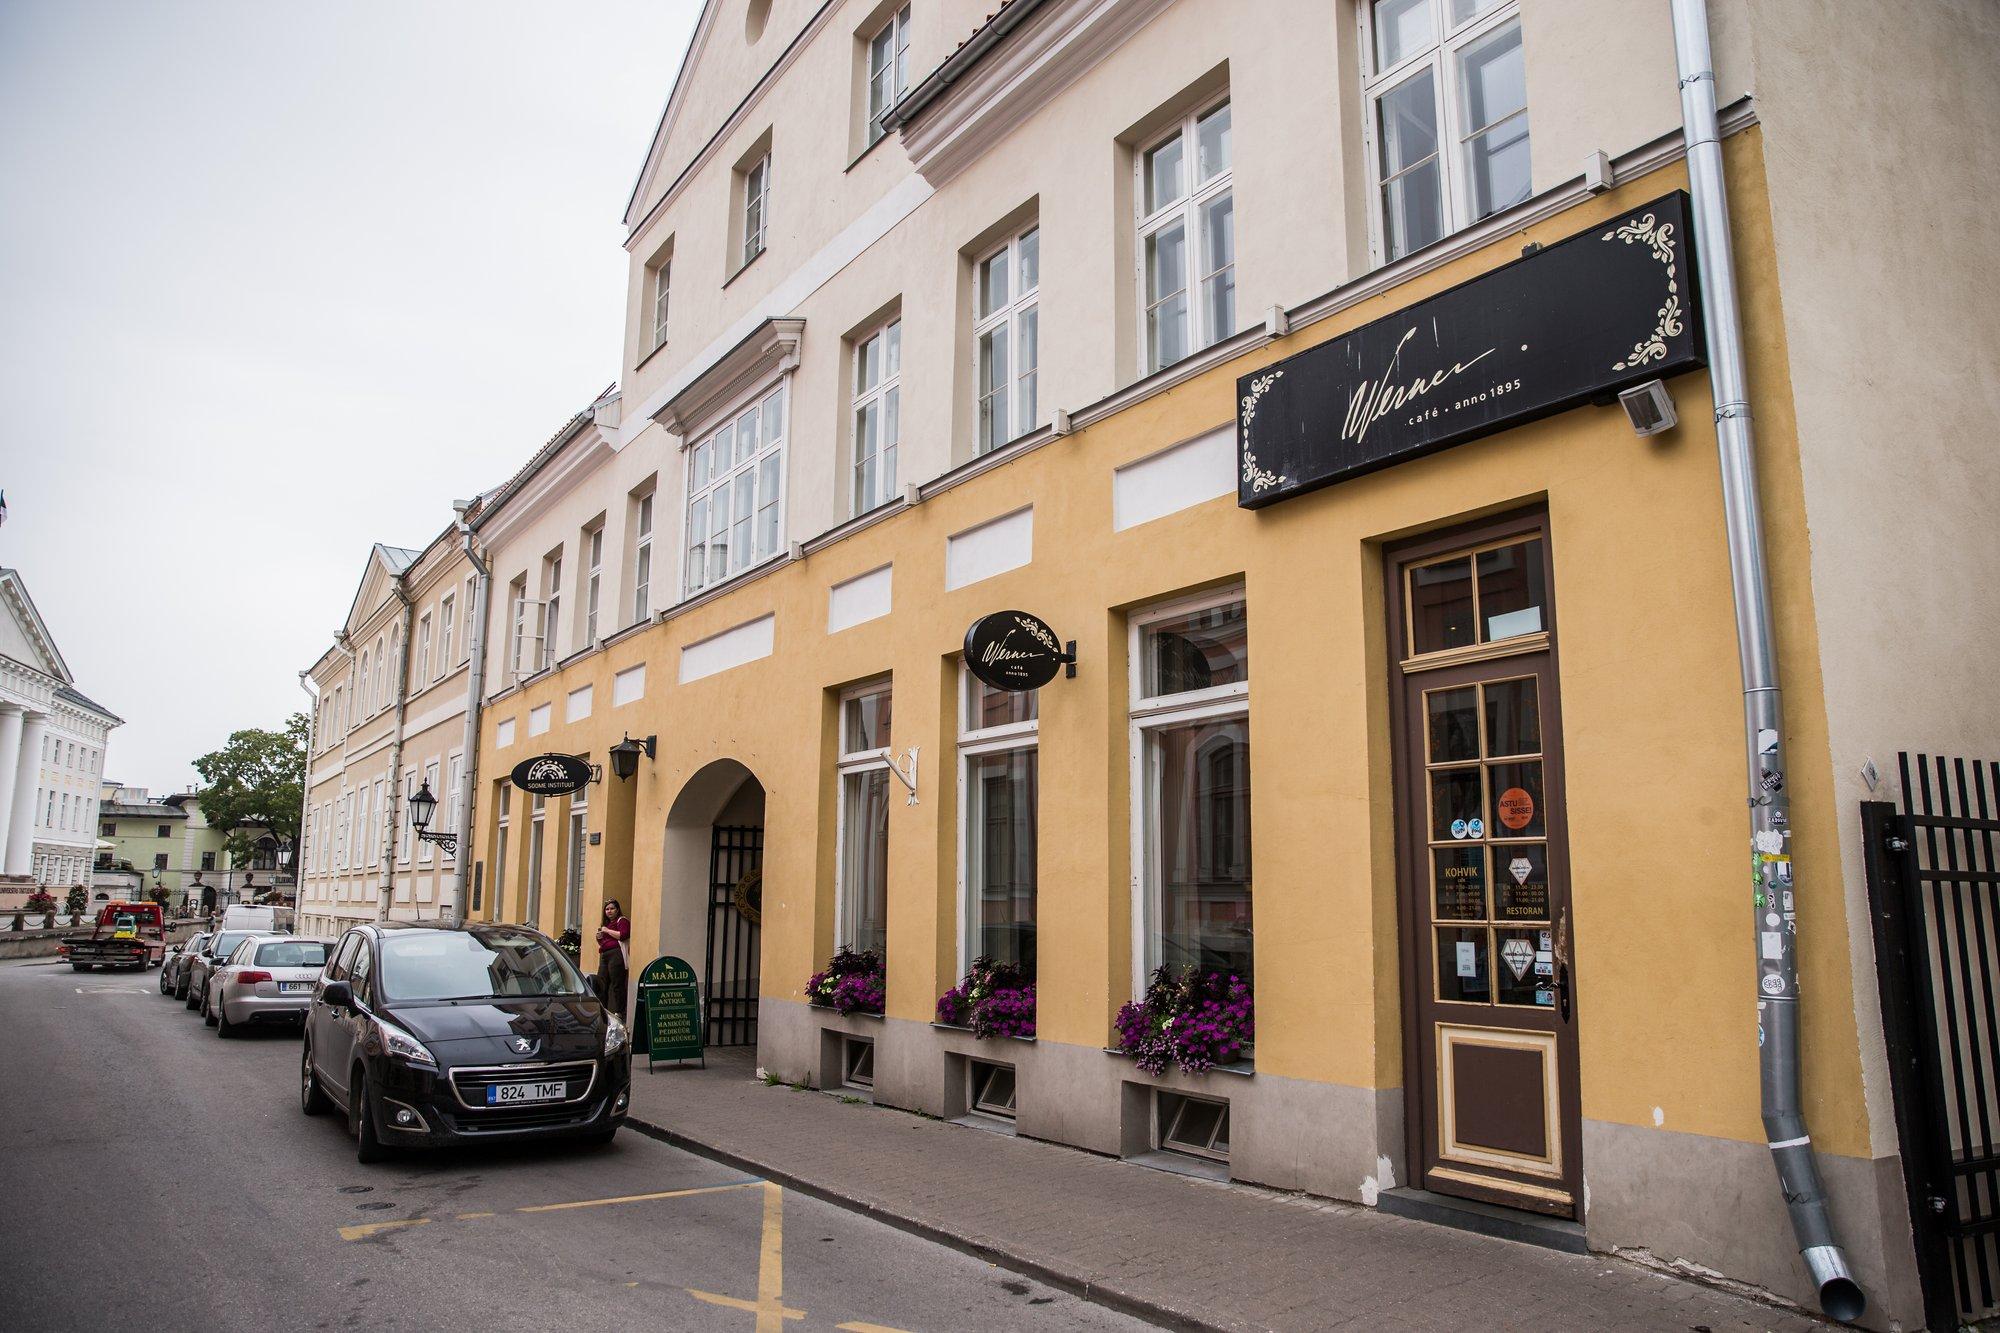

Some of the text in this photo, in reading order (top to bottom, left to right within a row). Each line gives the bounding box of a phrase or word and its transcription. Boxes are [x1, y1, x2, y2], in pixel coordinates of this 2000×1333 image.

[1341, 327, 1496, 444] Werner
[1408, 378, 1521, 426] café anno 1895
[981, 629, 1045, 667] Werner
[1499, 800, 1518, 808] ASTU
[1445, 866, 1478, 878] KOHVIK
[1506, 906, 1544, 915] RESTORAN
[652, 971, 689, 980] MAALID
[658, 997, 687, 1005] ANTIQUE
[501, 1082, 563, 1100] 824 TMF
